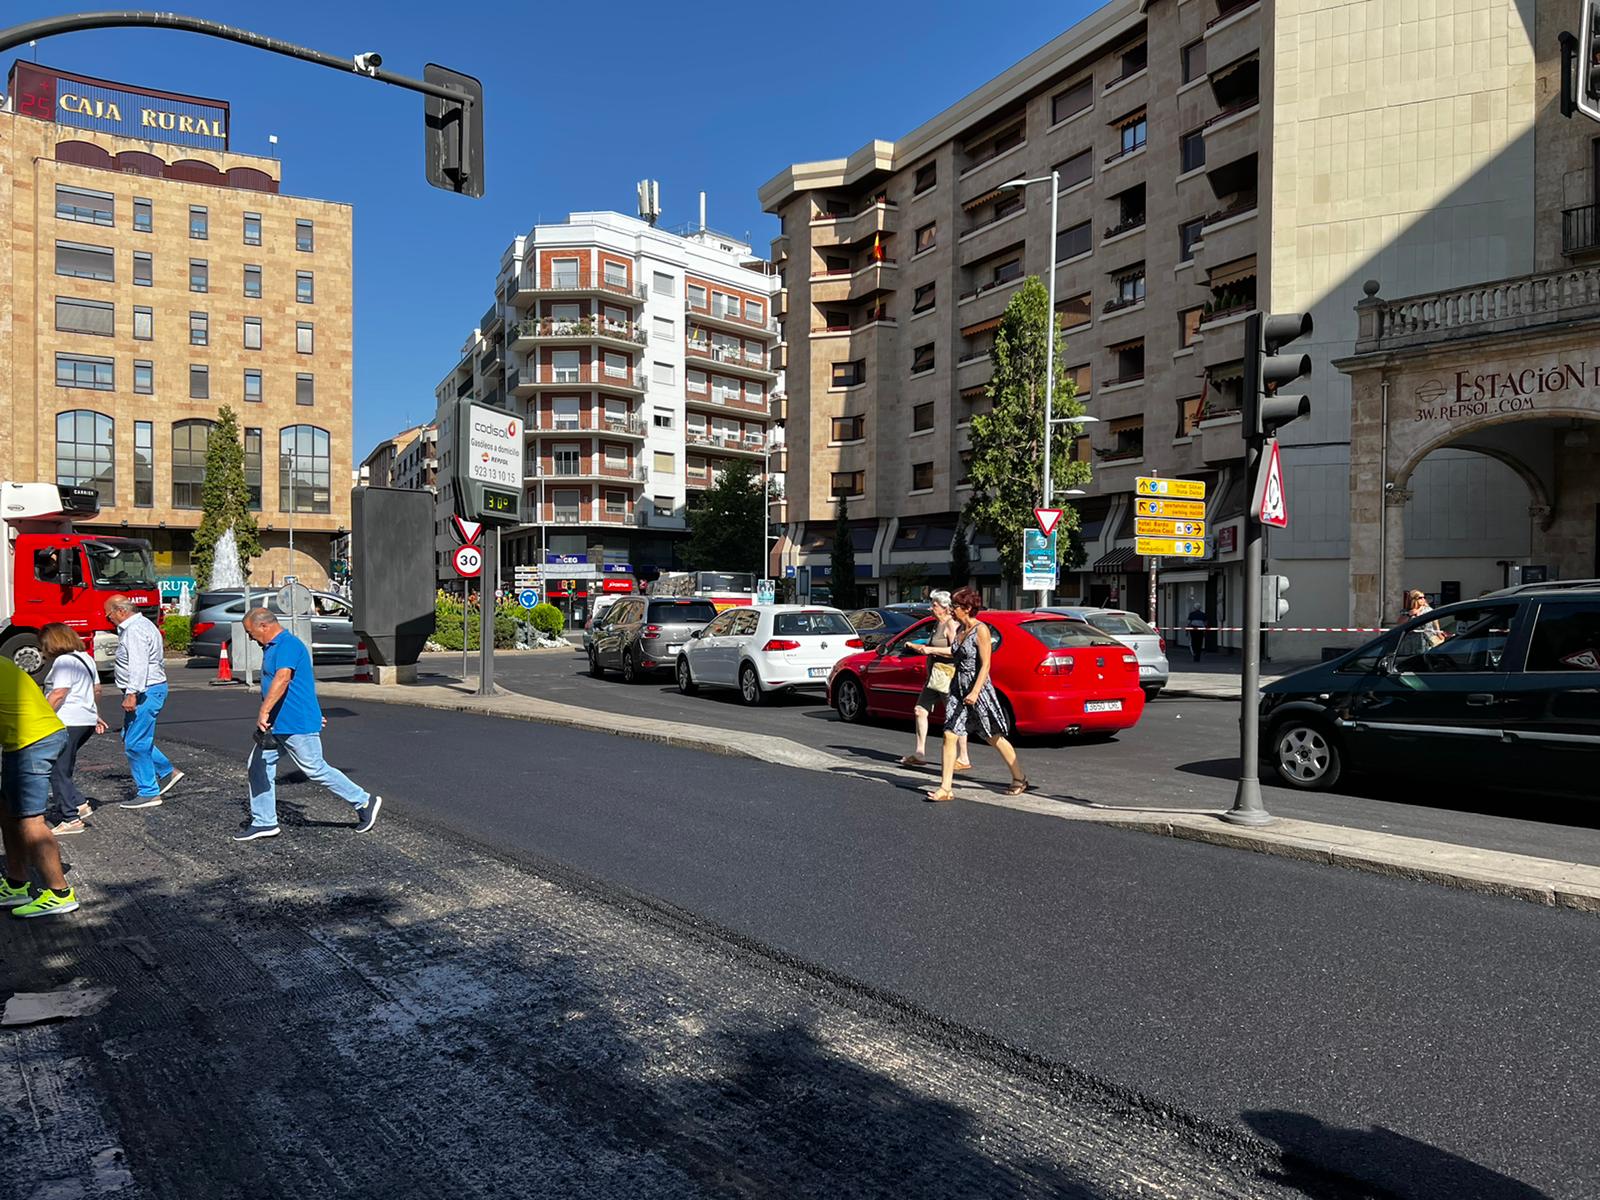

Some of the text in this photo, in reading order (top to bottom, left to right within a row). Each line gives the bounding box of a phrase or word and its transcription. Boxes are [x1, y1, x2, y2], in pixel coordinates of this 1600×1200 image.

[19, 93, 51, 119] 25
[59, 94, 226, 138] CAJA RURAL
[471, 438, 493, 450] Gasóleos
[498, 445, 520, 457] domicilio
[474, 465, 516, 483] 923 13 10 15
[460, 555, 478, 566] 30
